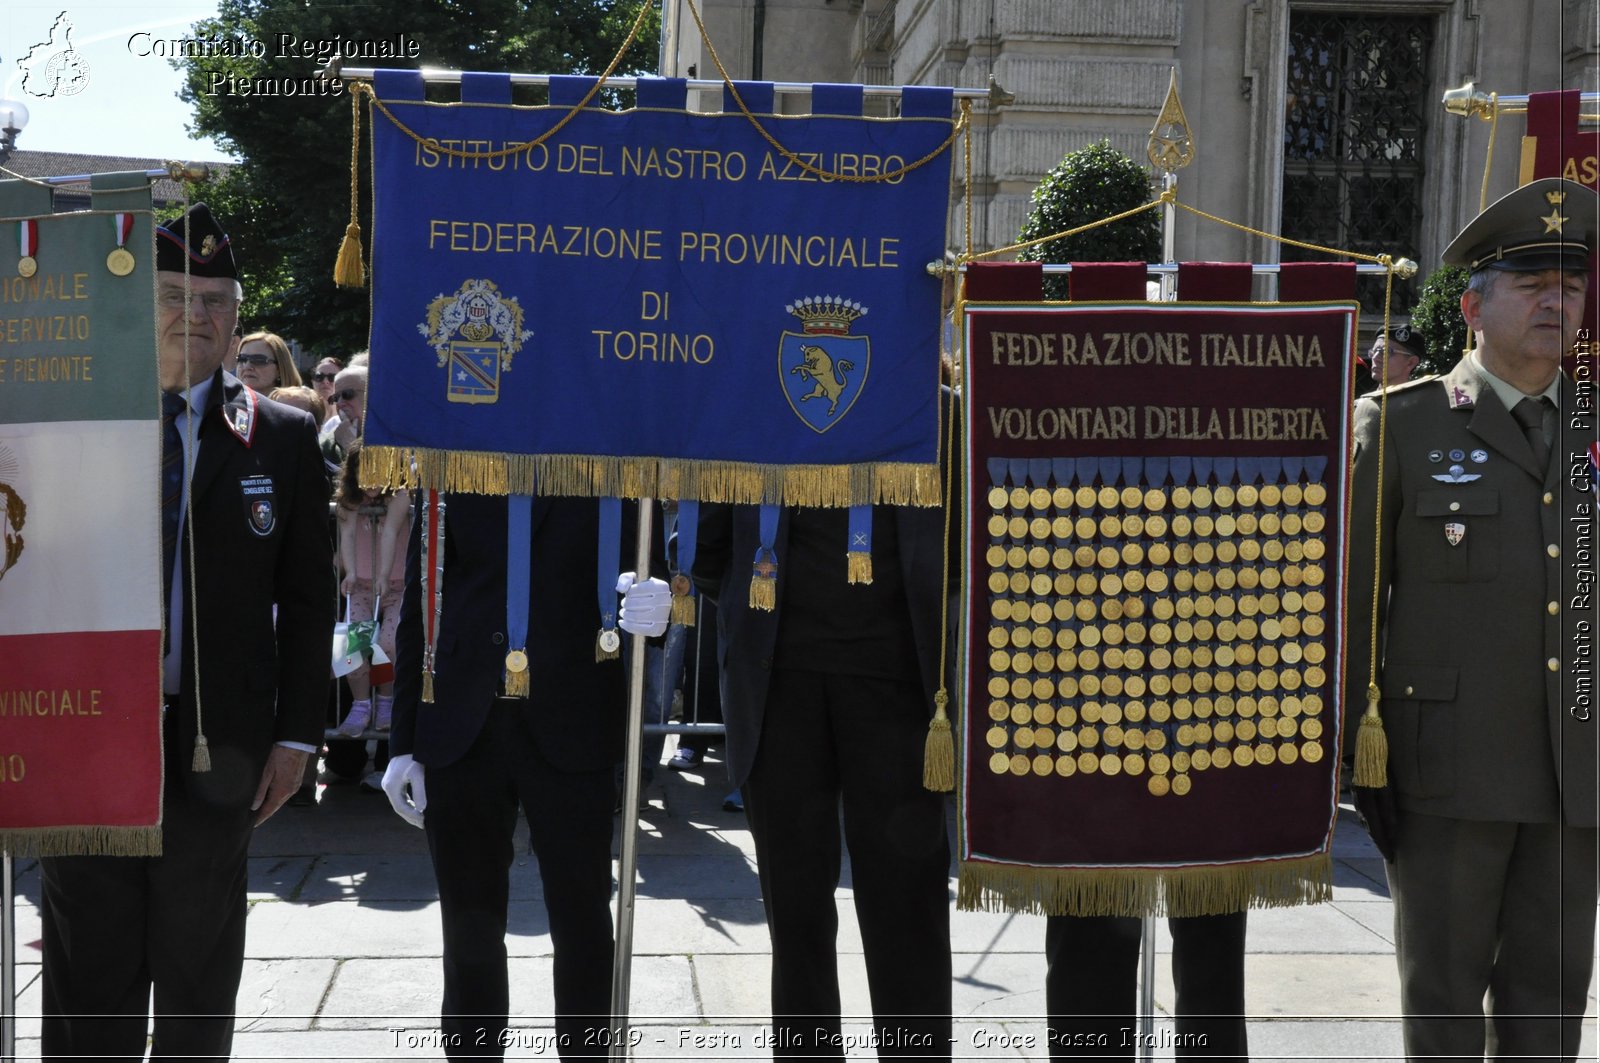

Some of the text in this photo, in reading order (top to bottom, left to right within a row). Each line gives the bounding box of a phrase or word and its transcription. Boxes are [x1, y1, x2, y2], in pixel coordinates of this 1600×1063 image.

[416, 138, 905, 185] ISTITUTO DEL NASTRO AZZURRO
[429, 219, 900, 268] FEDERAZIONE PROVINCIALE
[641, 291, 670, 322] DI
[592, 329, 715, 364] TORINO
[990, 331, 1326, 369] FEDERAZIONE ITALIANA
[14, 356, 93, 383] PIEMONTE
[988, 405, 1137, 441] VOLONTARI
[1144, 405, 1228, 441] DELLA
